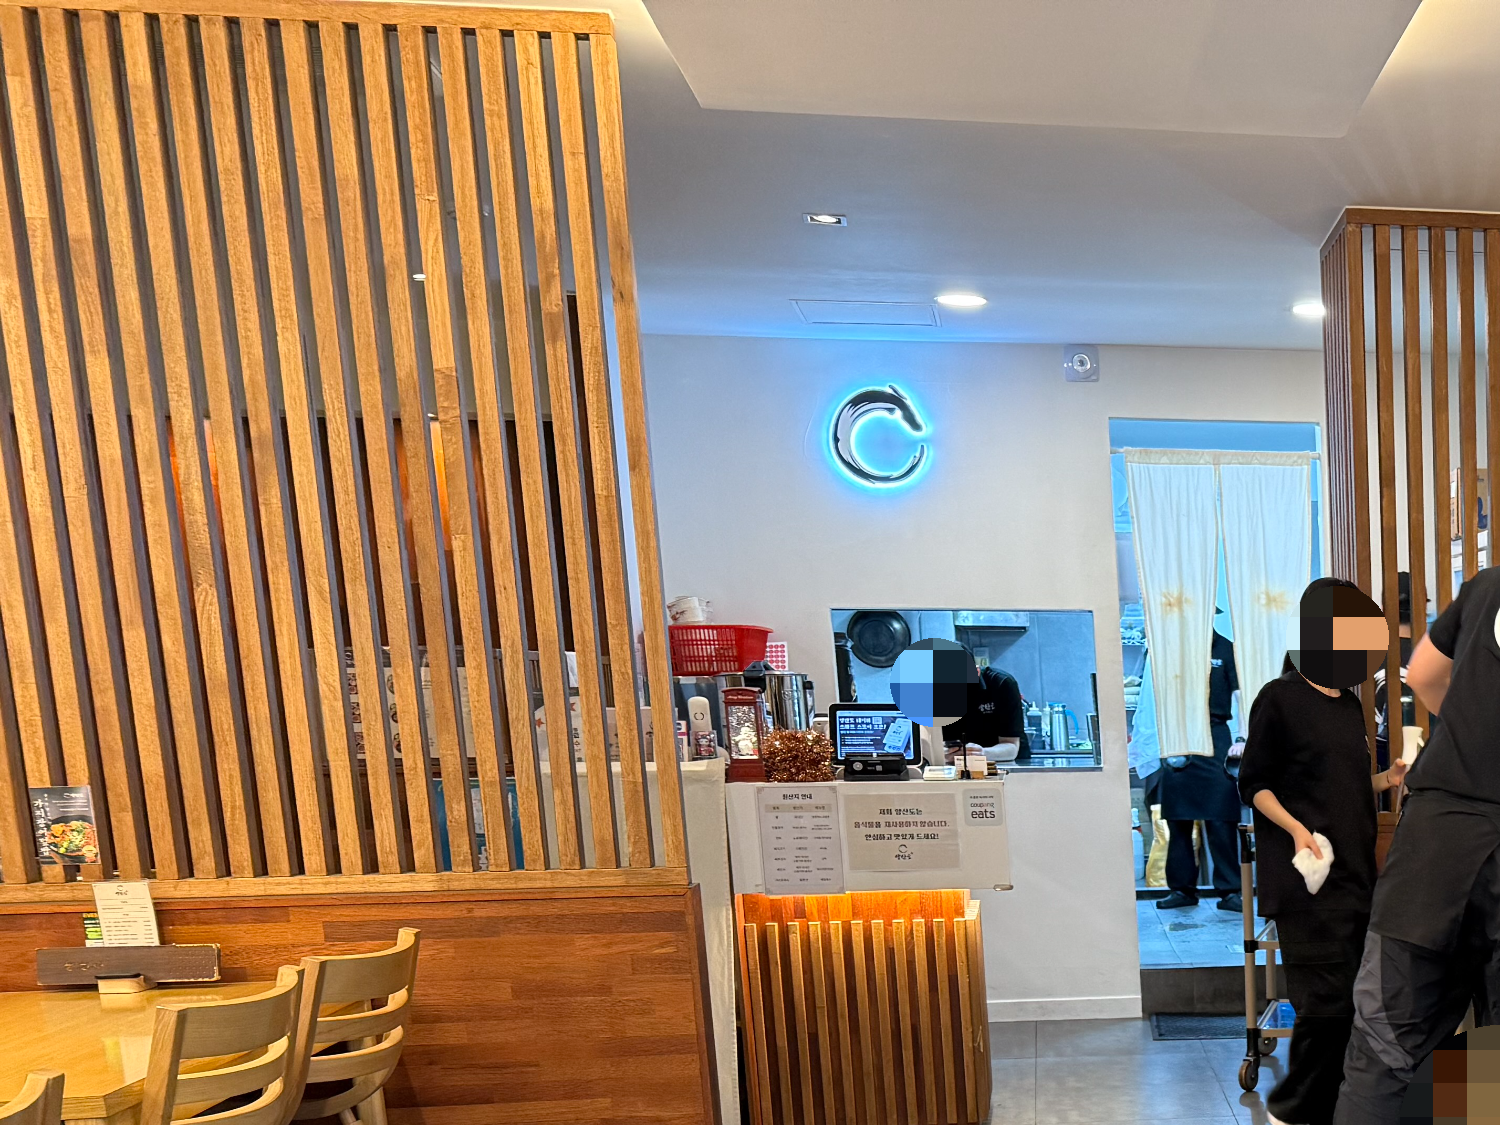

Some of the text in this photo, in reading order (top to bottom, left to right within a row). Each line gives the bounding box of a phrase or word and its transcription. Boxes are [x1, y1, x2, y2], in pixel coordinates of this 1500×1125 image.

[971, 808, 996, 819] eats
[864, 833, 893, 841] 안심하고
[916, 832, 939, 840] 드세요!
